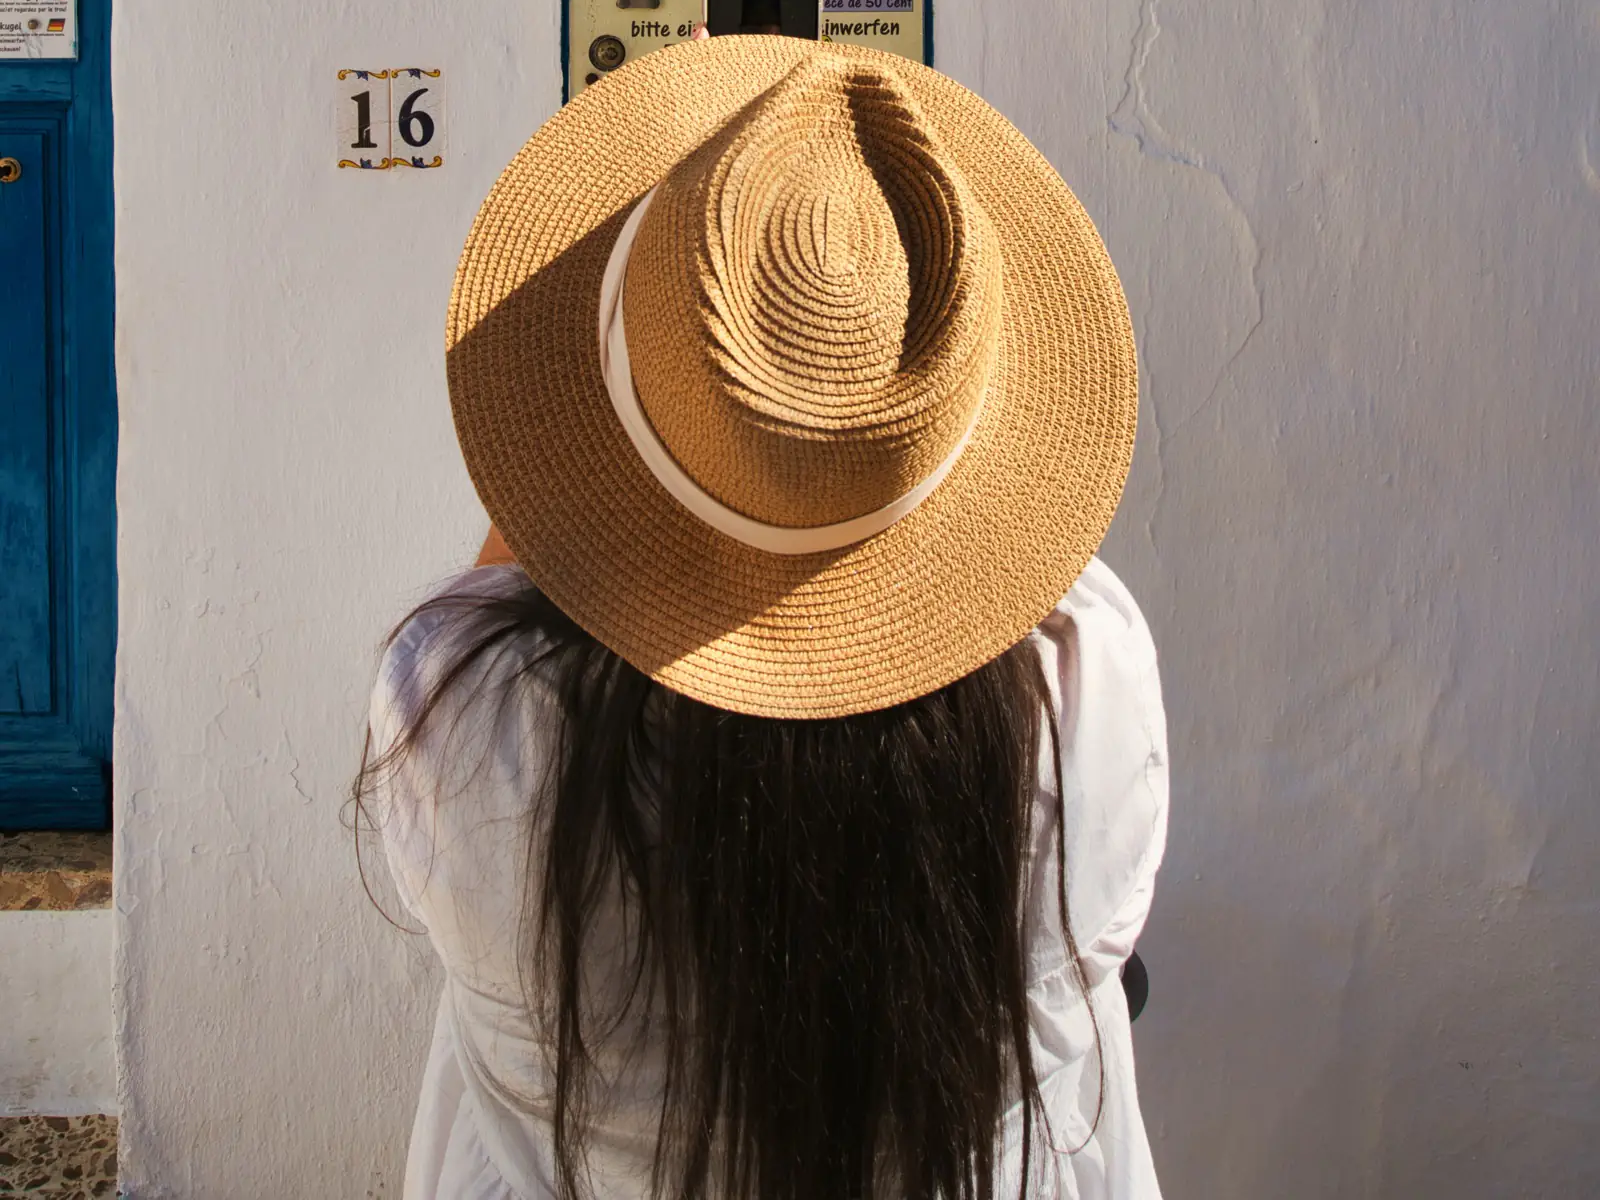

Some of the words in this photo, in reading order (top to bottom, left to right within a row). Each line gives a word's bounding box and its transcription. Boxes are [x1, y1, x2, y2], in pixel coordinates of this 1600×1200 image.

[631, 20, 671, 37] bitte
[677, 20, 694, 37] ei
[823, 18, 900, 36] inwerfen
[351, 88, 435, 148] 16
